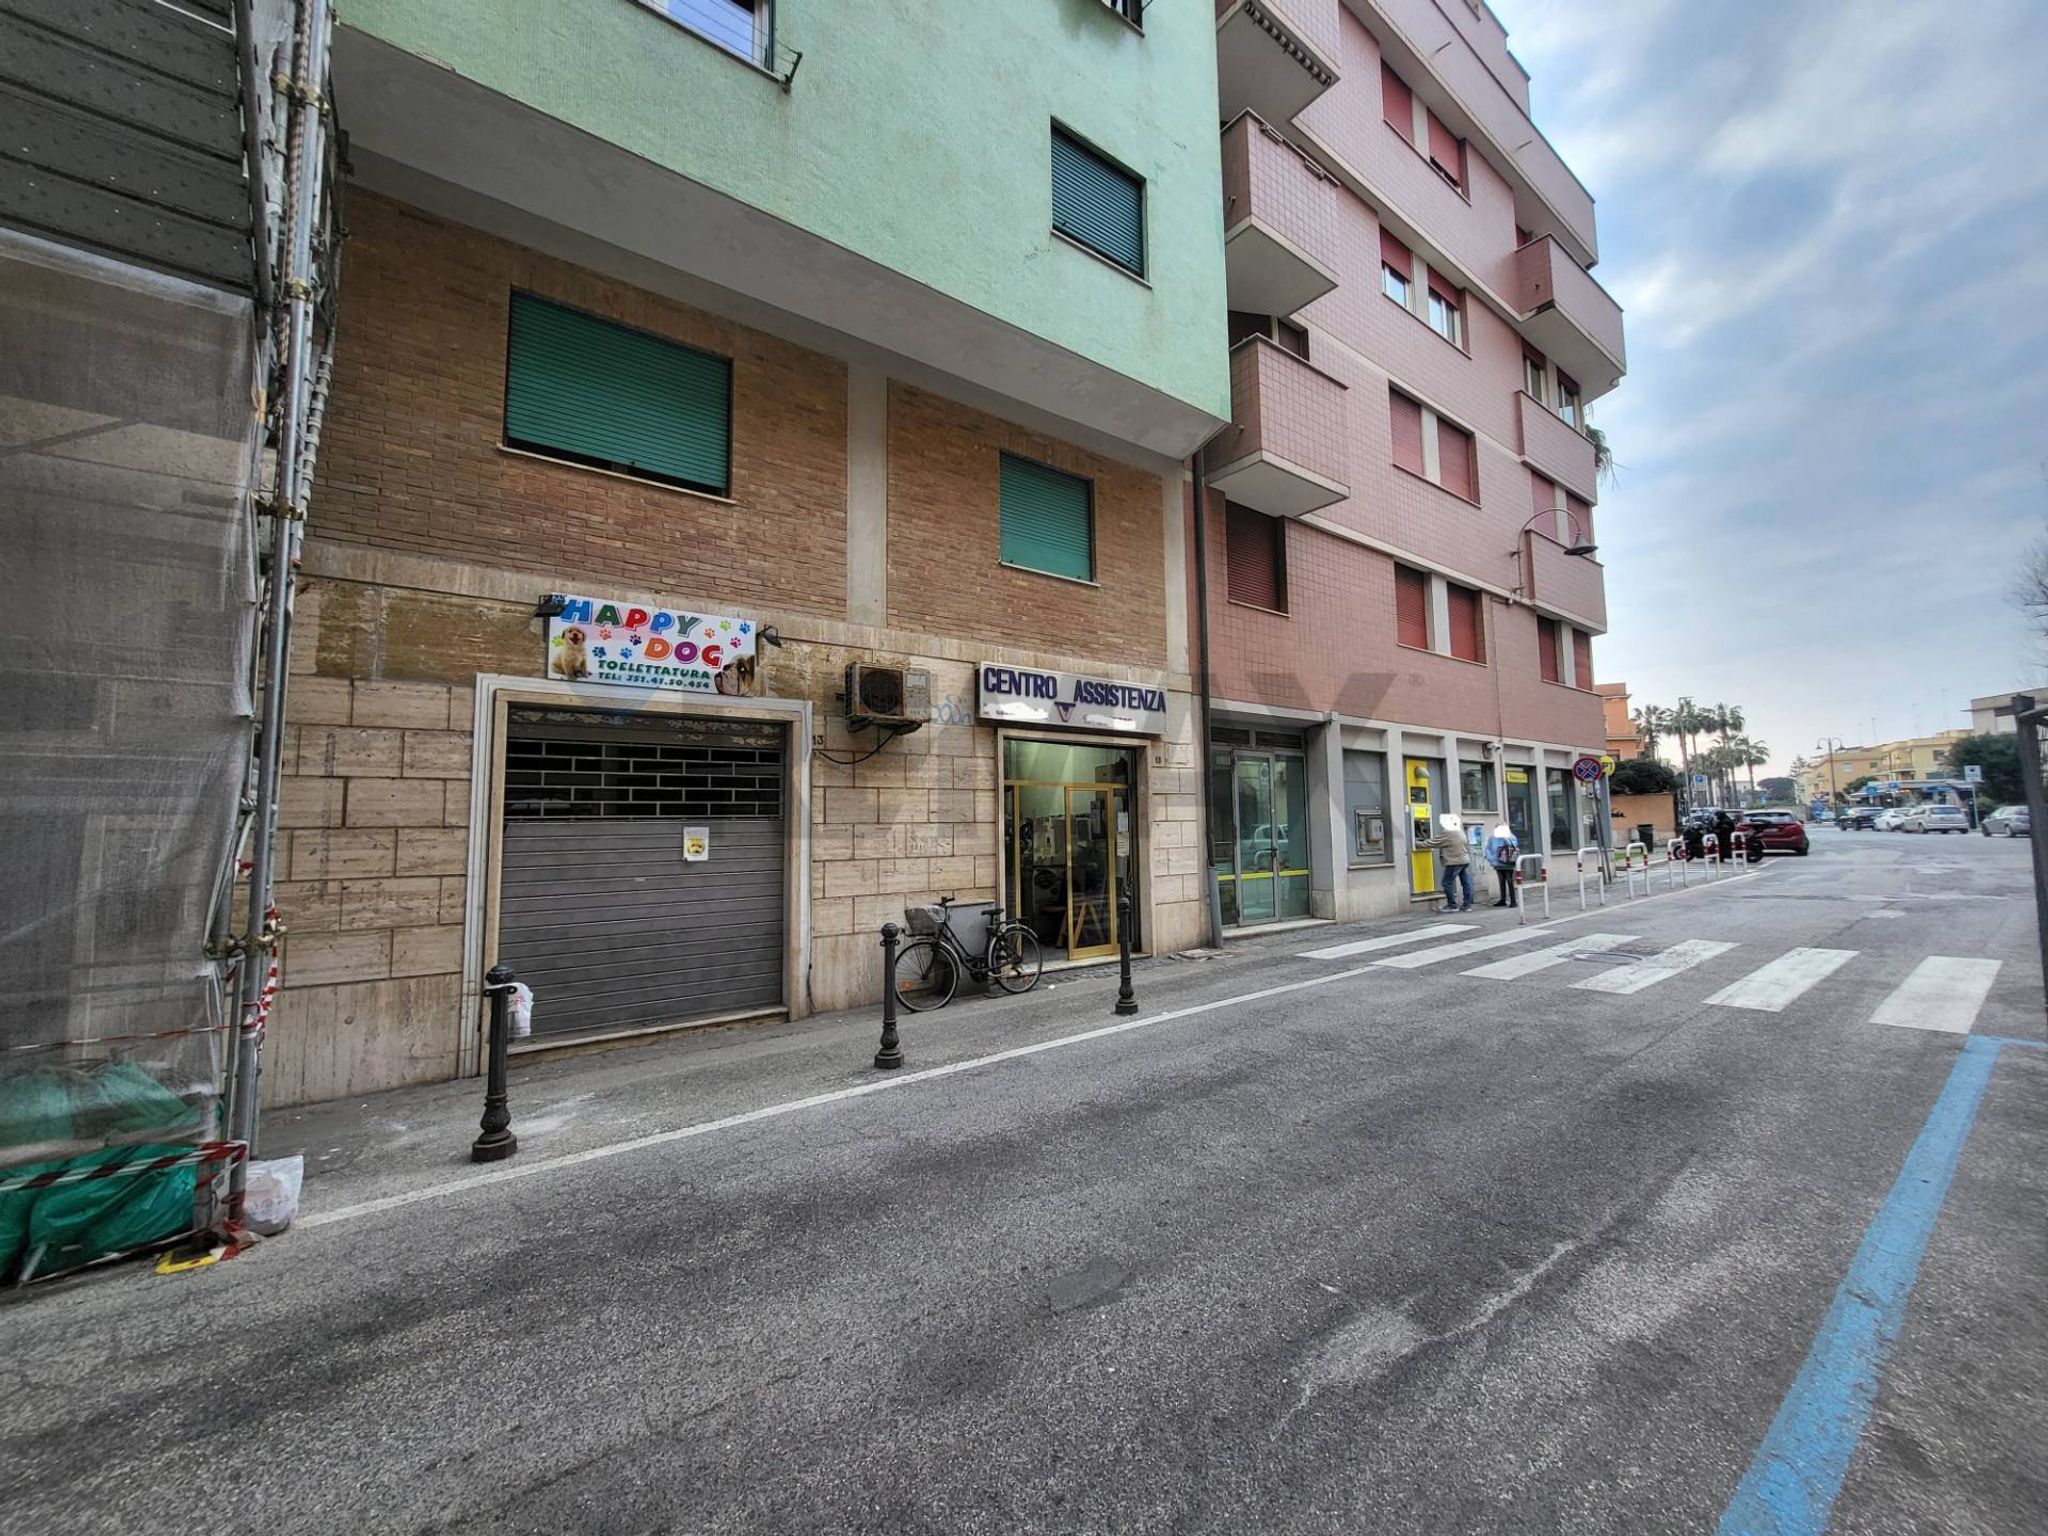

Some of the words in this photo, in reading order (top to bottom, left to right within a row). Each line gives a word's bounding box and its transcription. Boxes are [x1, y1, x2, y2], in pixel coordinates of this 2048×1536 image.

[560, 599, 701, 638] HAPPY
[597, 659, 711, 680] TOELETTATURA
[644, 637, 724, 670] DOG
[983, 667, 1057, 700] CENTRO
[1073, 679, 1167, 713] ASSISTENZA
